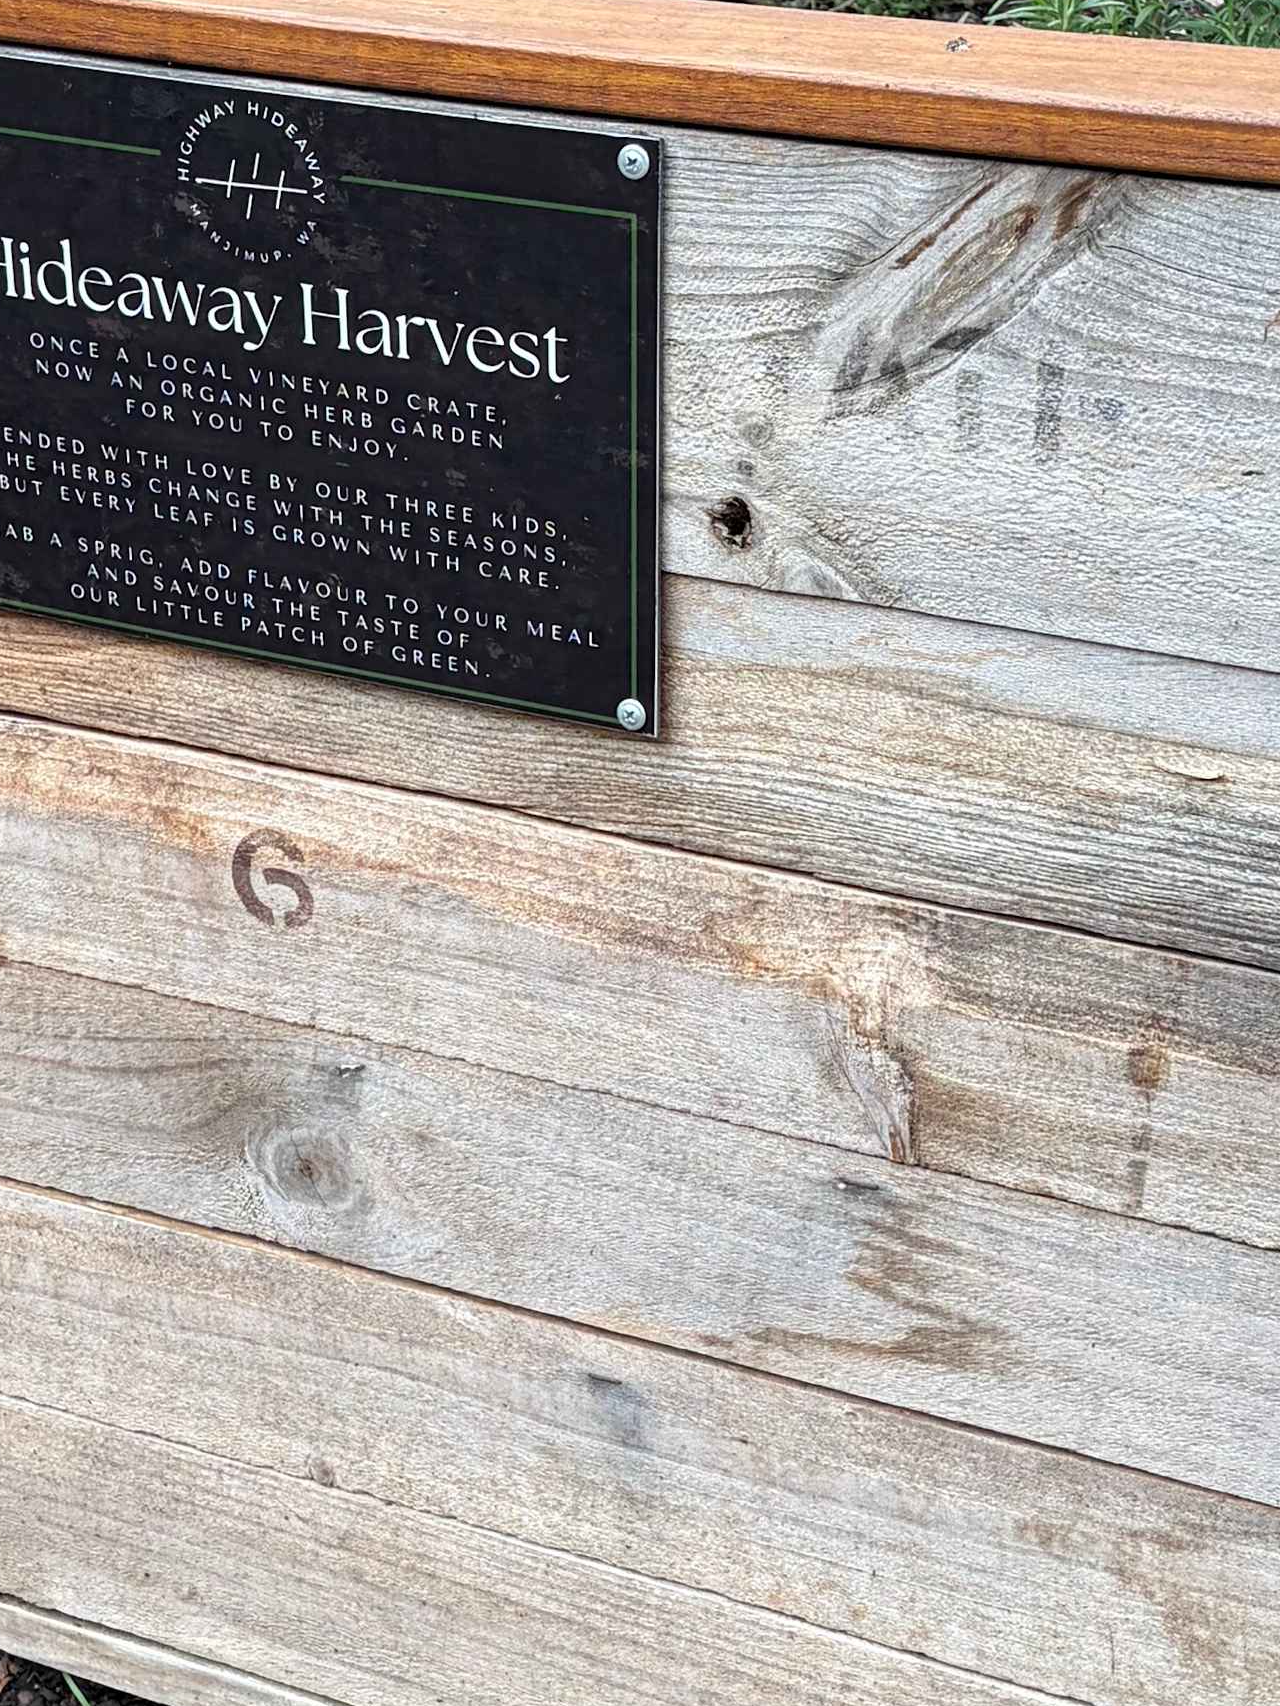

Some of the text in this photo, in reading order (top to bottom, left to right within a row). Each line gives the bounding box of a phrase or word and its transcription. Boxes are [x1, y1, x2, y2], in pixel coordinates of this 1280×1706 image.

[177, 100, 327, 205] HIGHWAY HIDEAWAY
[296, 220, 317, 245] WA
[29, 332, 506, 426] ONCE A LOCAL VINEYARD CRATE,
[300, 283, 570, 384] Harvest
[36, 359, 503, 449] NOW AN ORGANIC HERB GARDEN
[126, 398, 408, 461] FOR YOU TO ENJOY.
[0, 473, 559, 590] BUT EVERY LEAF IS GROWN WITH CARE.
[52, 460, 132, 489] HERBS
[149, 477, 257, 511] CHANGE
[273, 499, 343, 526] WITH
[361, 514, 411, 538] THE
[429, 527, 566, 566] SEASONS,
[100, 444, 168, 470] WITH
[187, 459, 251, 485] LOVE
[269, 473, 297, 492] BY
[315, 482, 368, 505] OUR
[385, 493, 473, 523] THREE
[492, 512, 567, 540] KIDS,
[50, 532, 62, 547] A
[78, 537, 163, 568] SPRIG,
[181, 557, 230, 579] ADD
[248, 569, 368, 606] FLAVOUR
[385, 594, 419, 614] TO
[436, 604, 507, 631] YOUR
[527, 620, 599, 647] MEAL
[70, 583, 490, 678] OUR LITTLE PATCH OF GREEN.
[88, 563, 470, 648] AND SAVOUR THE TASTE OF
[231, 826, 315, 930] 6
